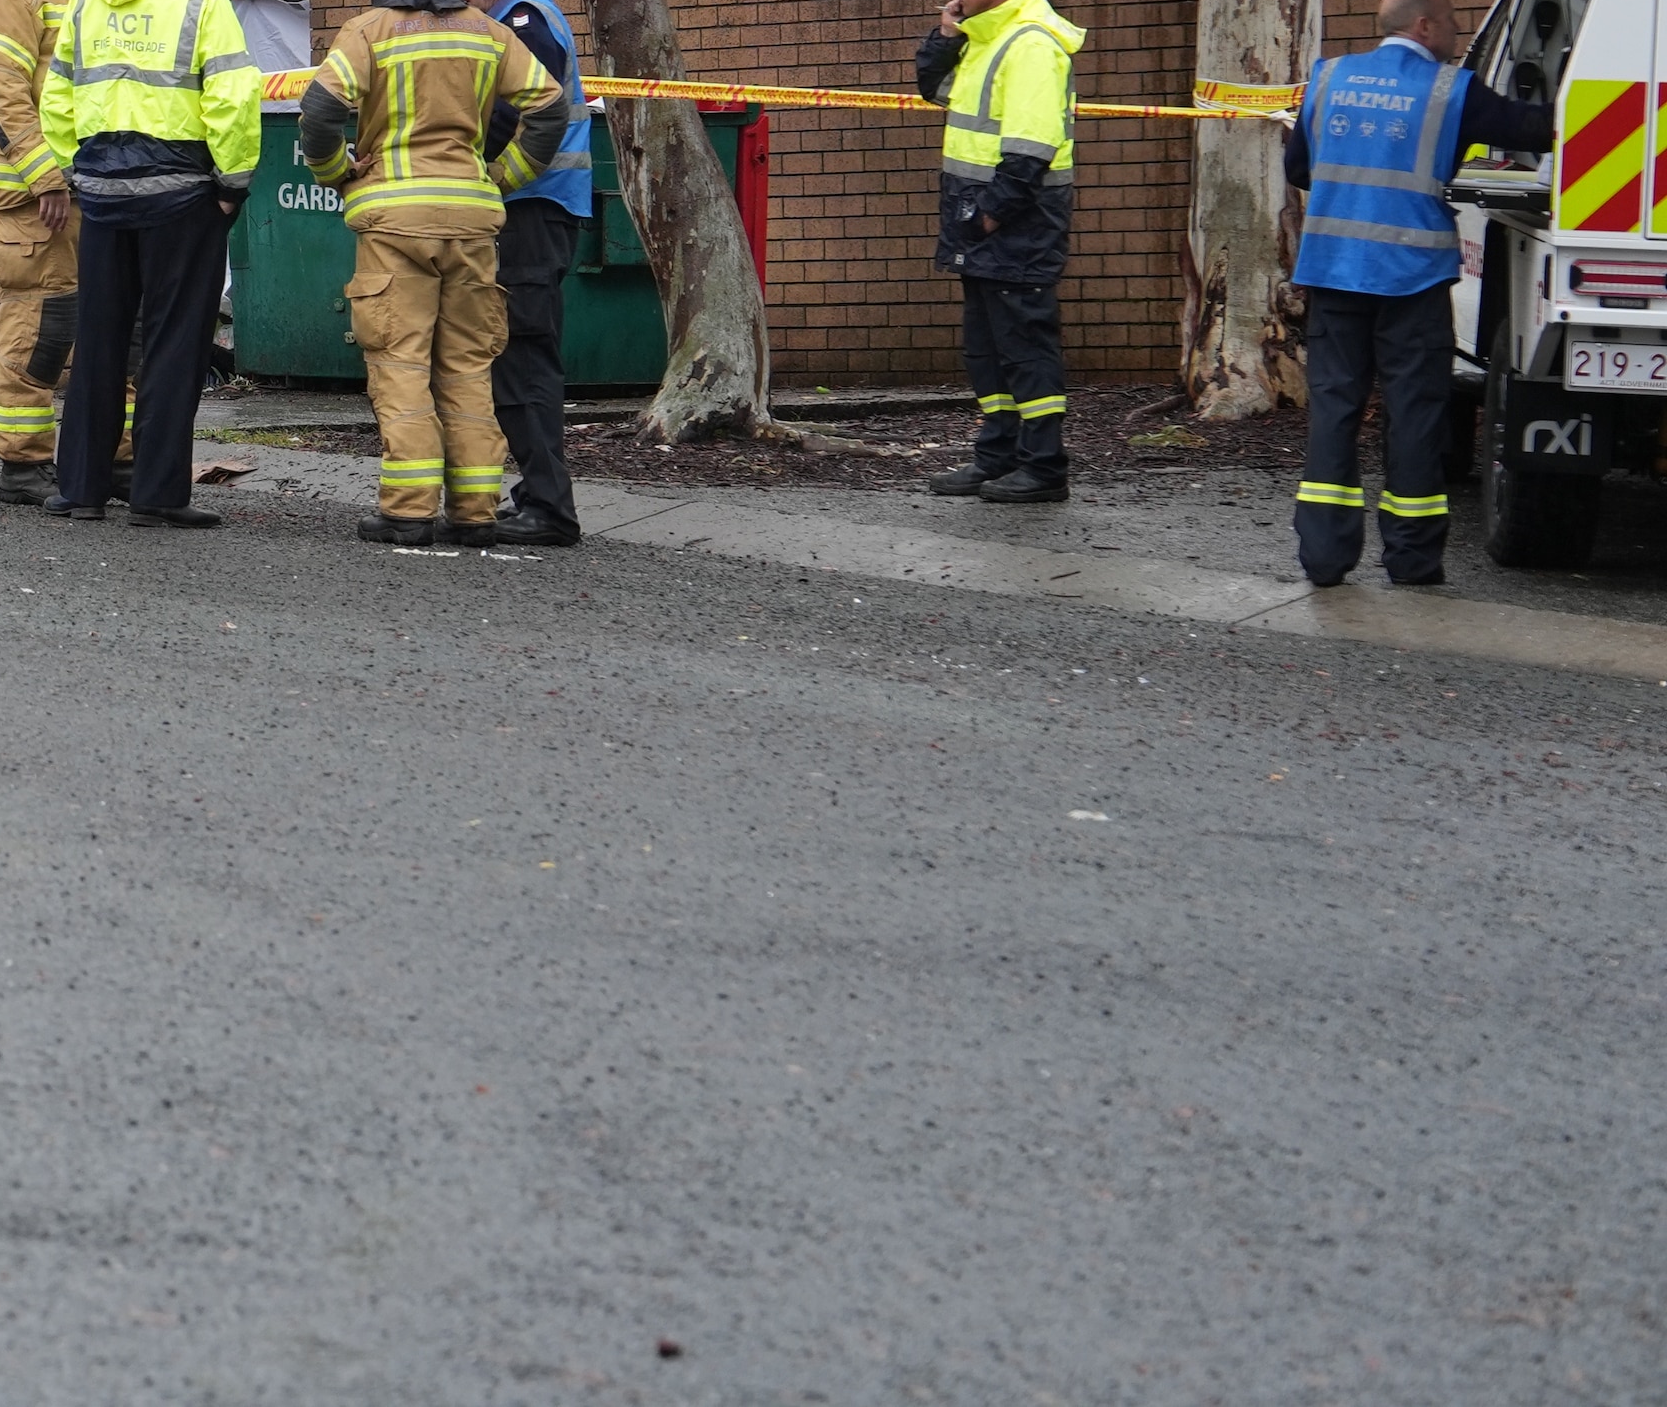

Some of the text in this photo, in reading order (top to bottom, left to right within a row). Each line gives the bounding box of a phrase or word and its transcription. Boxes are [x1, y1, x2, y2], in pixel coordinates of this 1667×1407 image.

[107, 12, 154, 35] ACT
[394, 18, 489, 33] FIRE & RESCUE
[115, 38, 167, 53] BRIGADE
[1330, 89, 1417, 112] HAZMAT
[1522, 413, 1591, 456] rxi
